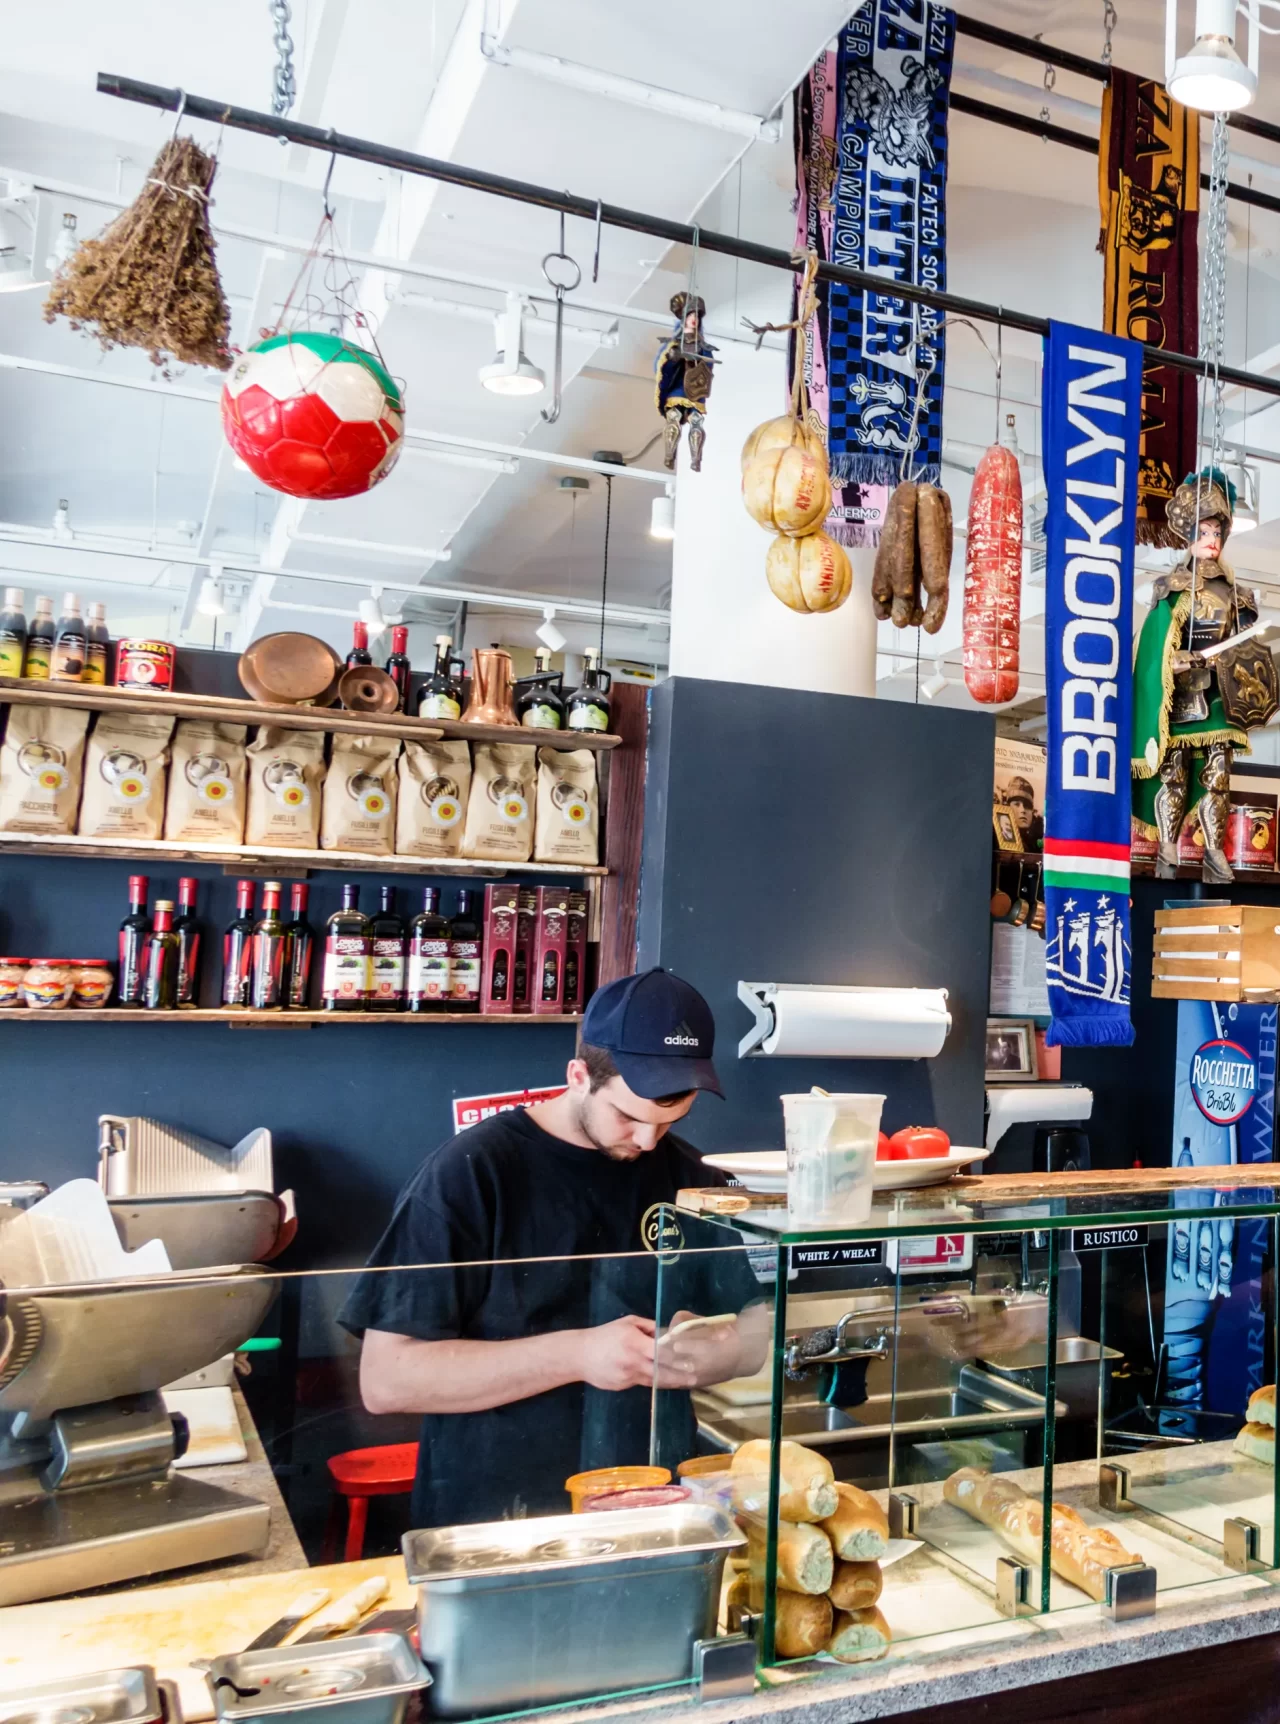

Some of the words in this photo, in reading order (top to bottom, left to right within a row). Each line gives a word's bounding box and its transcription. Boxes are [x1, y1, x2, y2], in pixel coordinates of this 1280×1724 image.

[804, 192, 820, 236] MADRE
[834, 133, 864, 286] CAMPION
[921, 180, 939, 246] FATECI
[829, 507, 882, 522] ALERMO
[1060, 344, 1128, 797] BROOKLYN
[124, 641, 169, 655] CORA
[664, 1033, 699, 1047] adidas
[1191, 1054, 1256, 1091] ROCCHETTA
[1252, 1008, 1278, 1161] WATER
[797, 1249, 830, 1262] WHITE
[840, 1246, 878, 1260] WHEAT
[1083, 1228, 1139, 1246] RUSTICO
